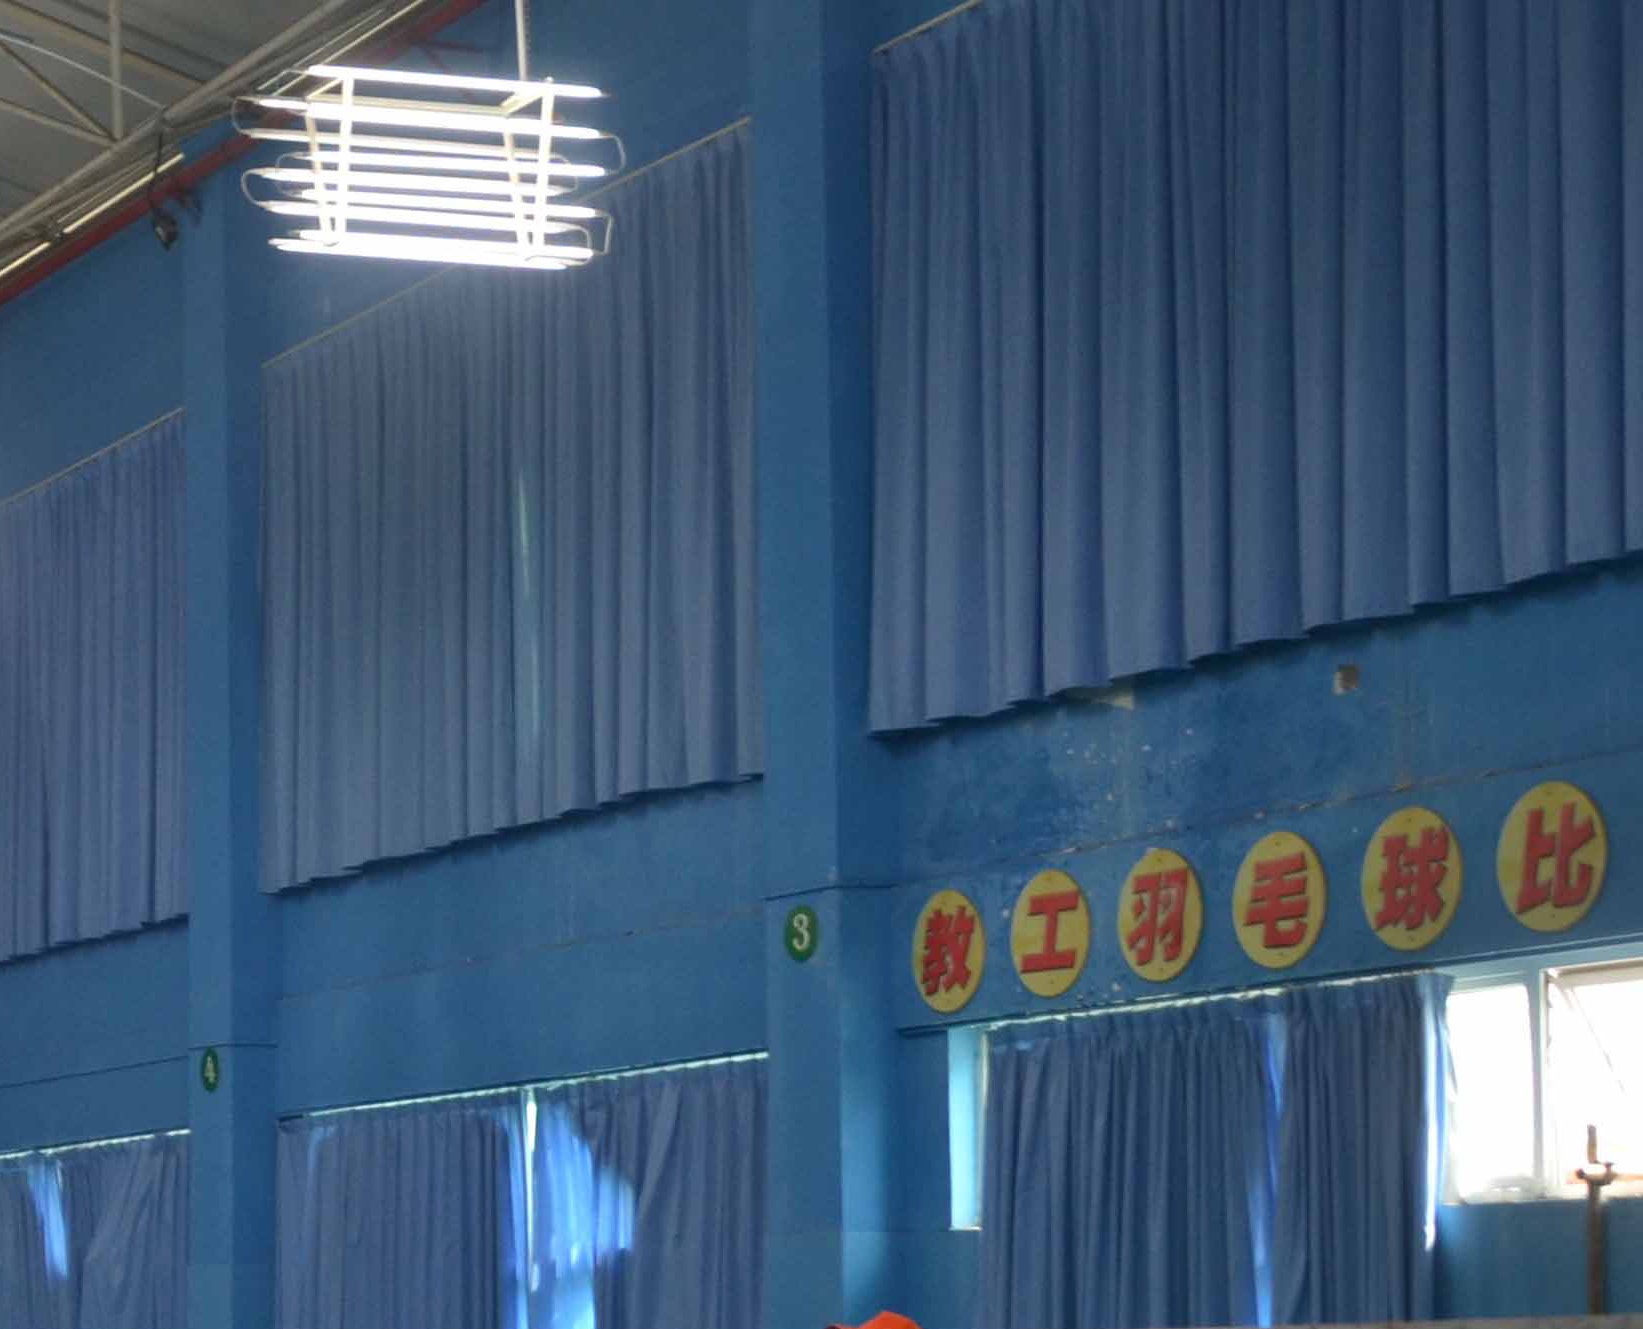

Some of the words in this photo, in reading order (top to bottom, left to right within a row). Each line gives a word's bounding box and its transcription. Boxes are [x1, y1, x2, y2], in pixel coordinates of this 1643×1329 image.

[792, 913, 811, 952] 3
[921, 801, 1597, 997] 教工羽毛球比
